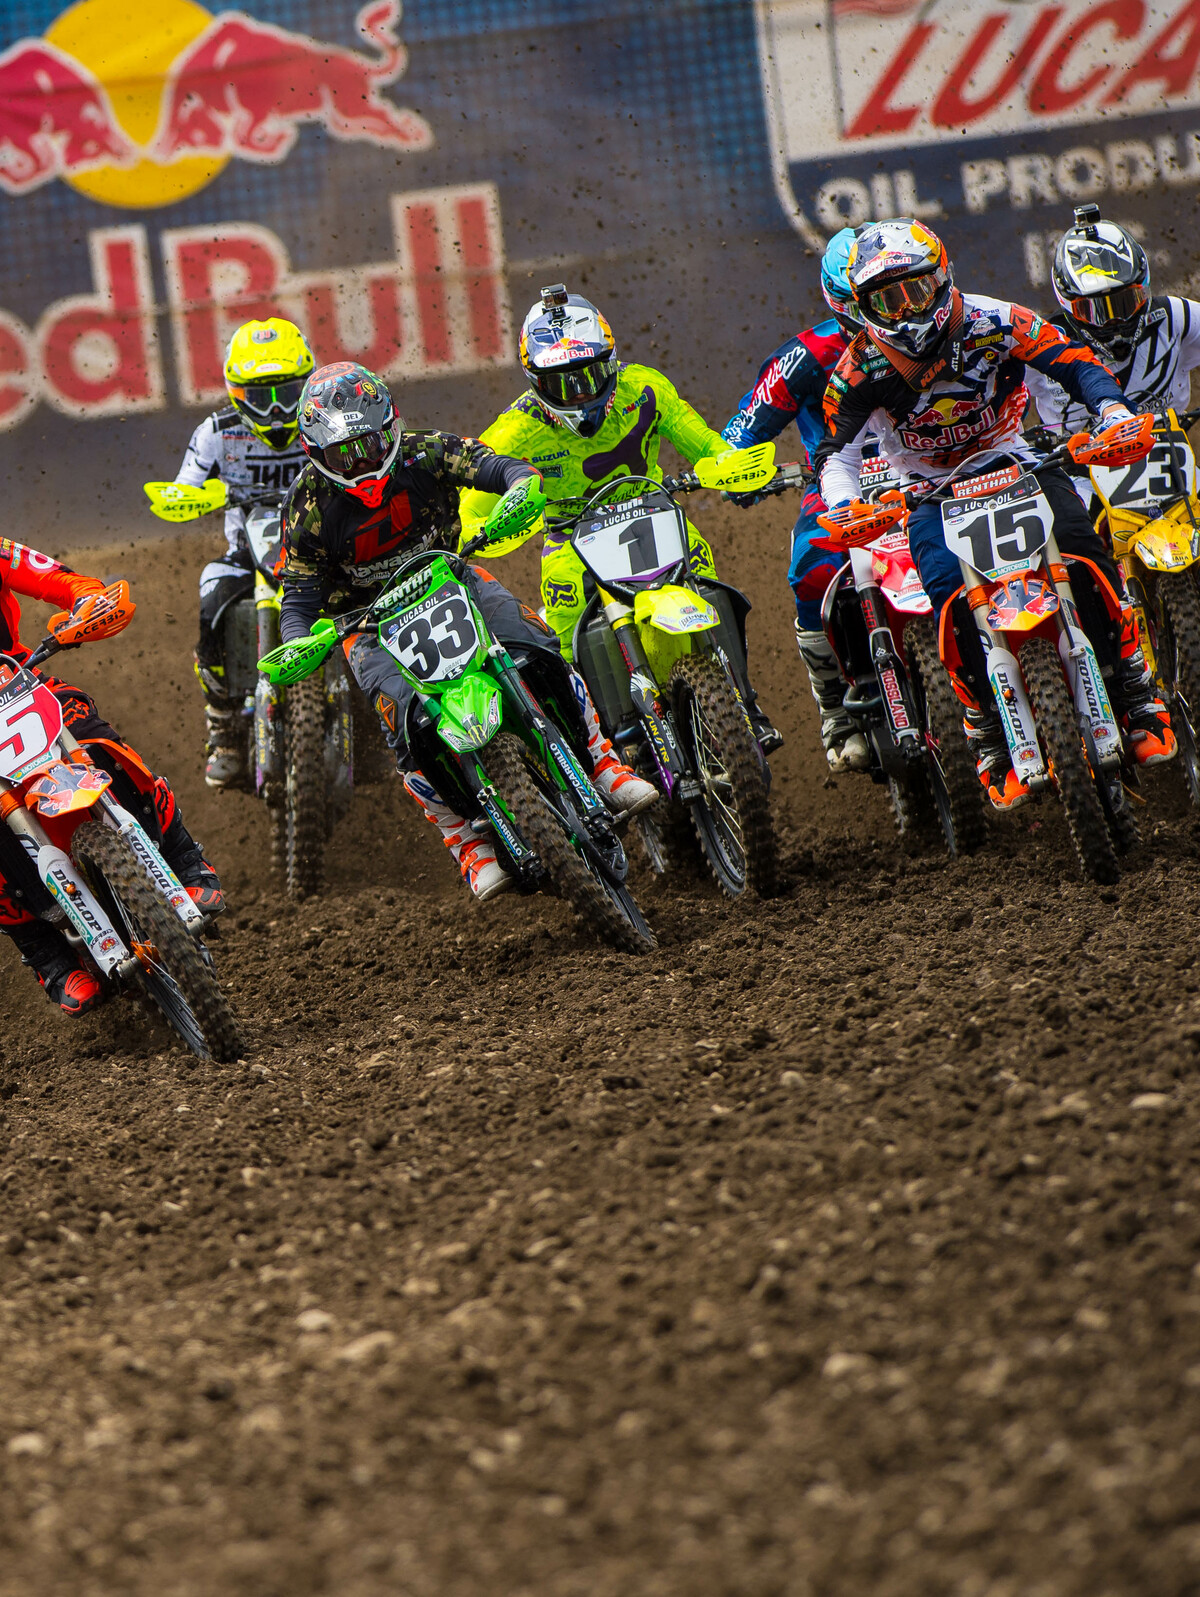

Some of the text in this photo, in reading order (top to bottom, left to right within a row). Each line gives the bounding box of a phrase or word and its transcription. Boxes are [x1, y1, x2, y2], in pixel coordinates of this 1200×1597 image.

[815, 167, 943, 234] OIL
[159, 180, 520, 408] Bull
[543, 348, 595, 367] Red Bull
[951, 340, 961, 371] ATLAS
[902, 405, 996, 450] Red Bull
[531, 450, 571, 463] SUZUKI
[1089, 441, 1144, 463] ACERBIS
[246, 460, 308, 489] THO
[715, 469, 768, 487] ACERBIS
[957, 475, 1016, 498] RENTHAL
[1109, 445, 1188, 507] 23
[998, 492, 1014, 505] OIL
[489, 500, 535, 538] ACERBIS
[604, 508, 647, 527] LUCAS OIL
[840, 515, 895, 540] ACERBIS
[618, 515, 660, 576] 1
[957, 499, 1047, 573] 15
[997, 560, 1029, 576] MOTOREX
[73, 608, 127, 640] ACERBIS
[398, 605, 424, 628] LUCAS
[425, 596, 440, 610] OIL
[397, 598, 477, 681] 33
[278, 643, 327, 677] ACERBIS
[20, 752, 52, 776] MOTOREX
[550, 742, 584, 790] CARRILLO
[492, 811, 523, 857] CARRILLO
[52, 869, 103, 932] DULOP
[57, 892, 92, 942] MOTOREX
